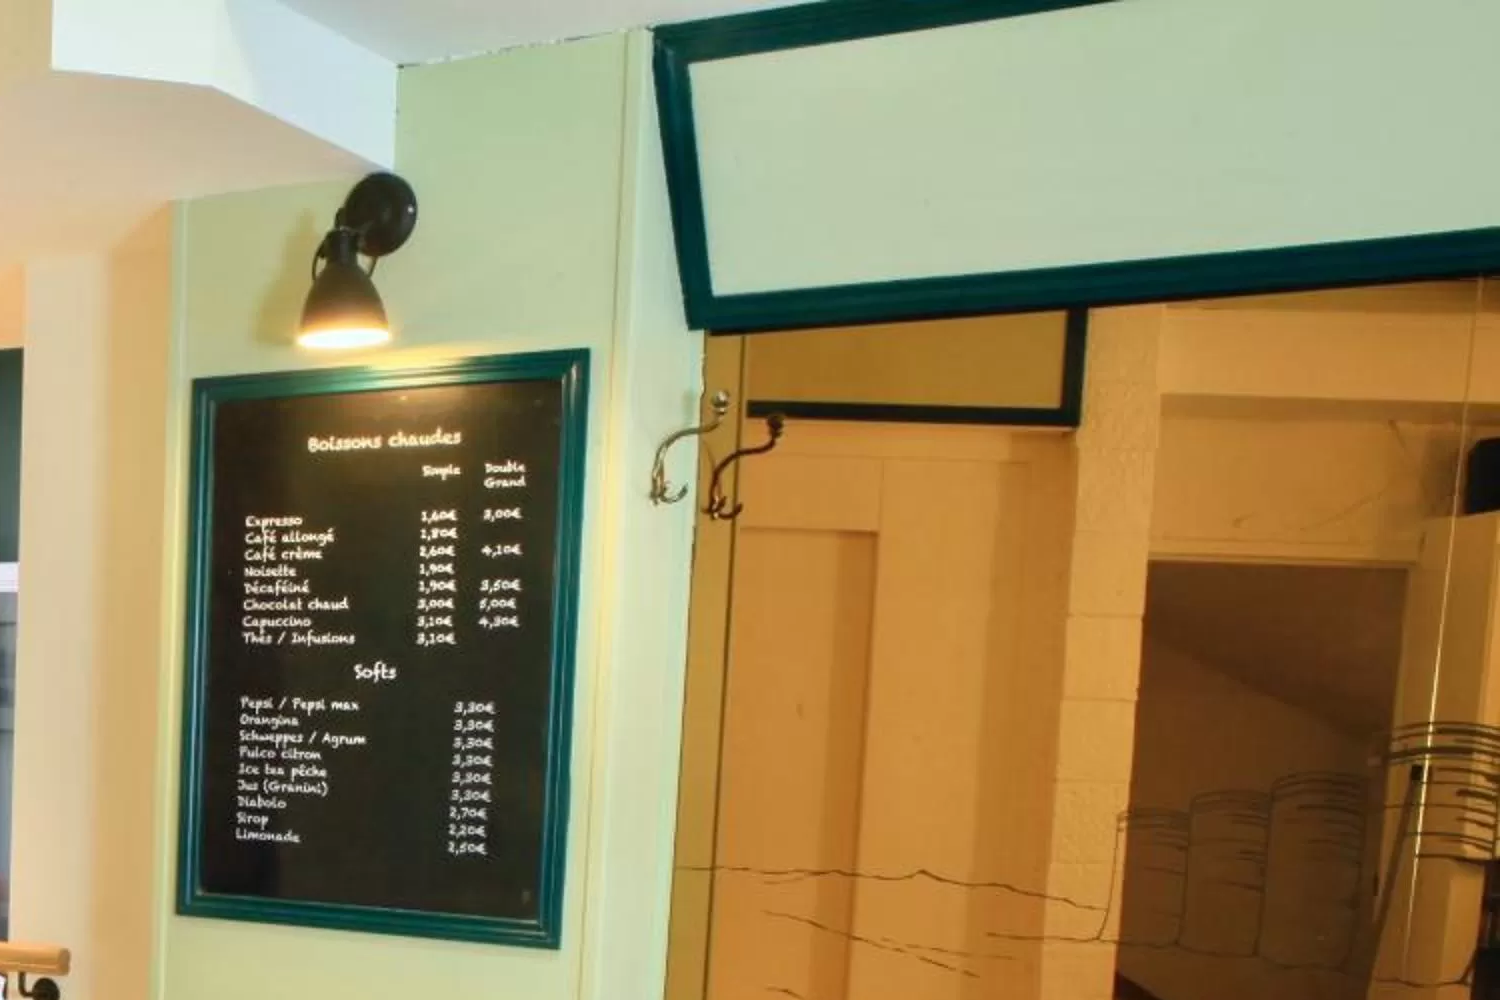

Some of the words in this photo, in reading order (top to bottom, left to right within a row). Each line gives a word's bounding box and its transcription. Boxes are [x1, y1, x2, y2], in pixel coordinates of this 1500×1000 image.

[307, 435, 382, 453] Boissons
[387, 426, 462, 448] chaudes
[422, 464, 461, 480] Simple
[484, 460, 526, 474] Double
[484, 476, 527, 489] Grand
[245, 516, 303, 533] Expresso
[421, 509, 458, 524] 1,60€
[245, 530, 278, 548] Café
[281, 527, 335, 547] allongé
[244, 546, 277, 563] Café
[281, 546, 323, 560] crème
[480, 544, 523, 559] 4,10€
[244, 564, 297, 577] Noisette
[419, 563, 455, 577] 1,90€
[244, 580, 310, 596] Décaféiné
[243, 598, 302, 611] Chocolat
[307, 597, 349, 610] chaud
[242, 616, 312, 631] Capuccino
[242, 631, 273, 645] Thés
[277, 631, 287, 645] /
[291, 629, 356, 647] Infusions
[353, 660, 398, 683] Softs
[240, 696, 274, 715] Pepsi
[278, 696, 288, 710] /
[291, 697, 326, 716] Pepsi
[331, 701, 360, 711] max
[239, 713, 300, 730] Orangina
[239, 729, 304, 749] Schweppes
[308, 730, 318, 744] /
[321, 732, 367, 749] Agrum
[239, 746, 277, 759] Pulco
[281, 747, 322, 760] citron
[238, 763, 261, 775] Ice
[265, 763, 285, 776] tea
[291, 763, 328, 782] pêche
[236, 779, 259, 791] Jus
[263, 778, 329, 797] (Granini)
[237, 795, 287, 809] Diabolo
[449, 806, 488, 821] 2,70€
[236, 812, 269, 830] Sirop
[235, 828, 300, 843] Limonade
